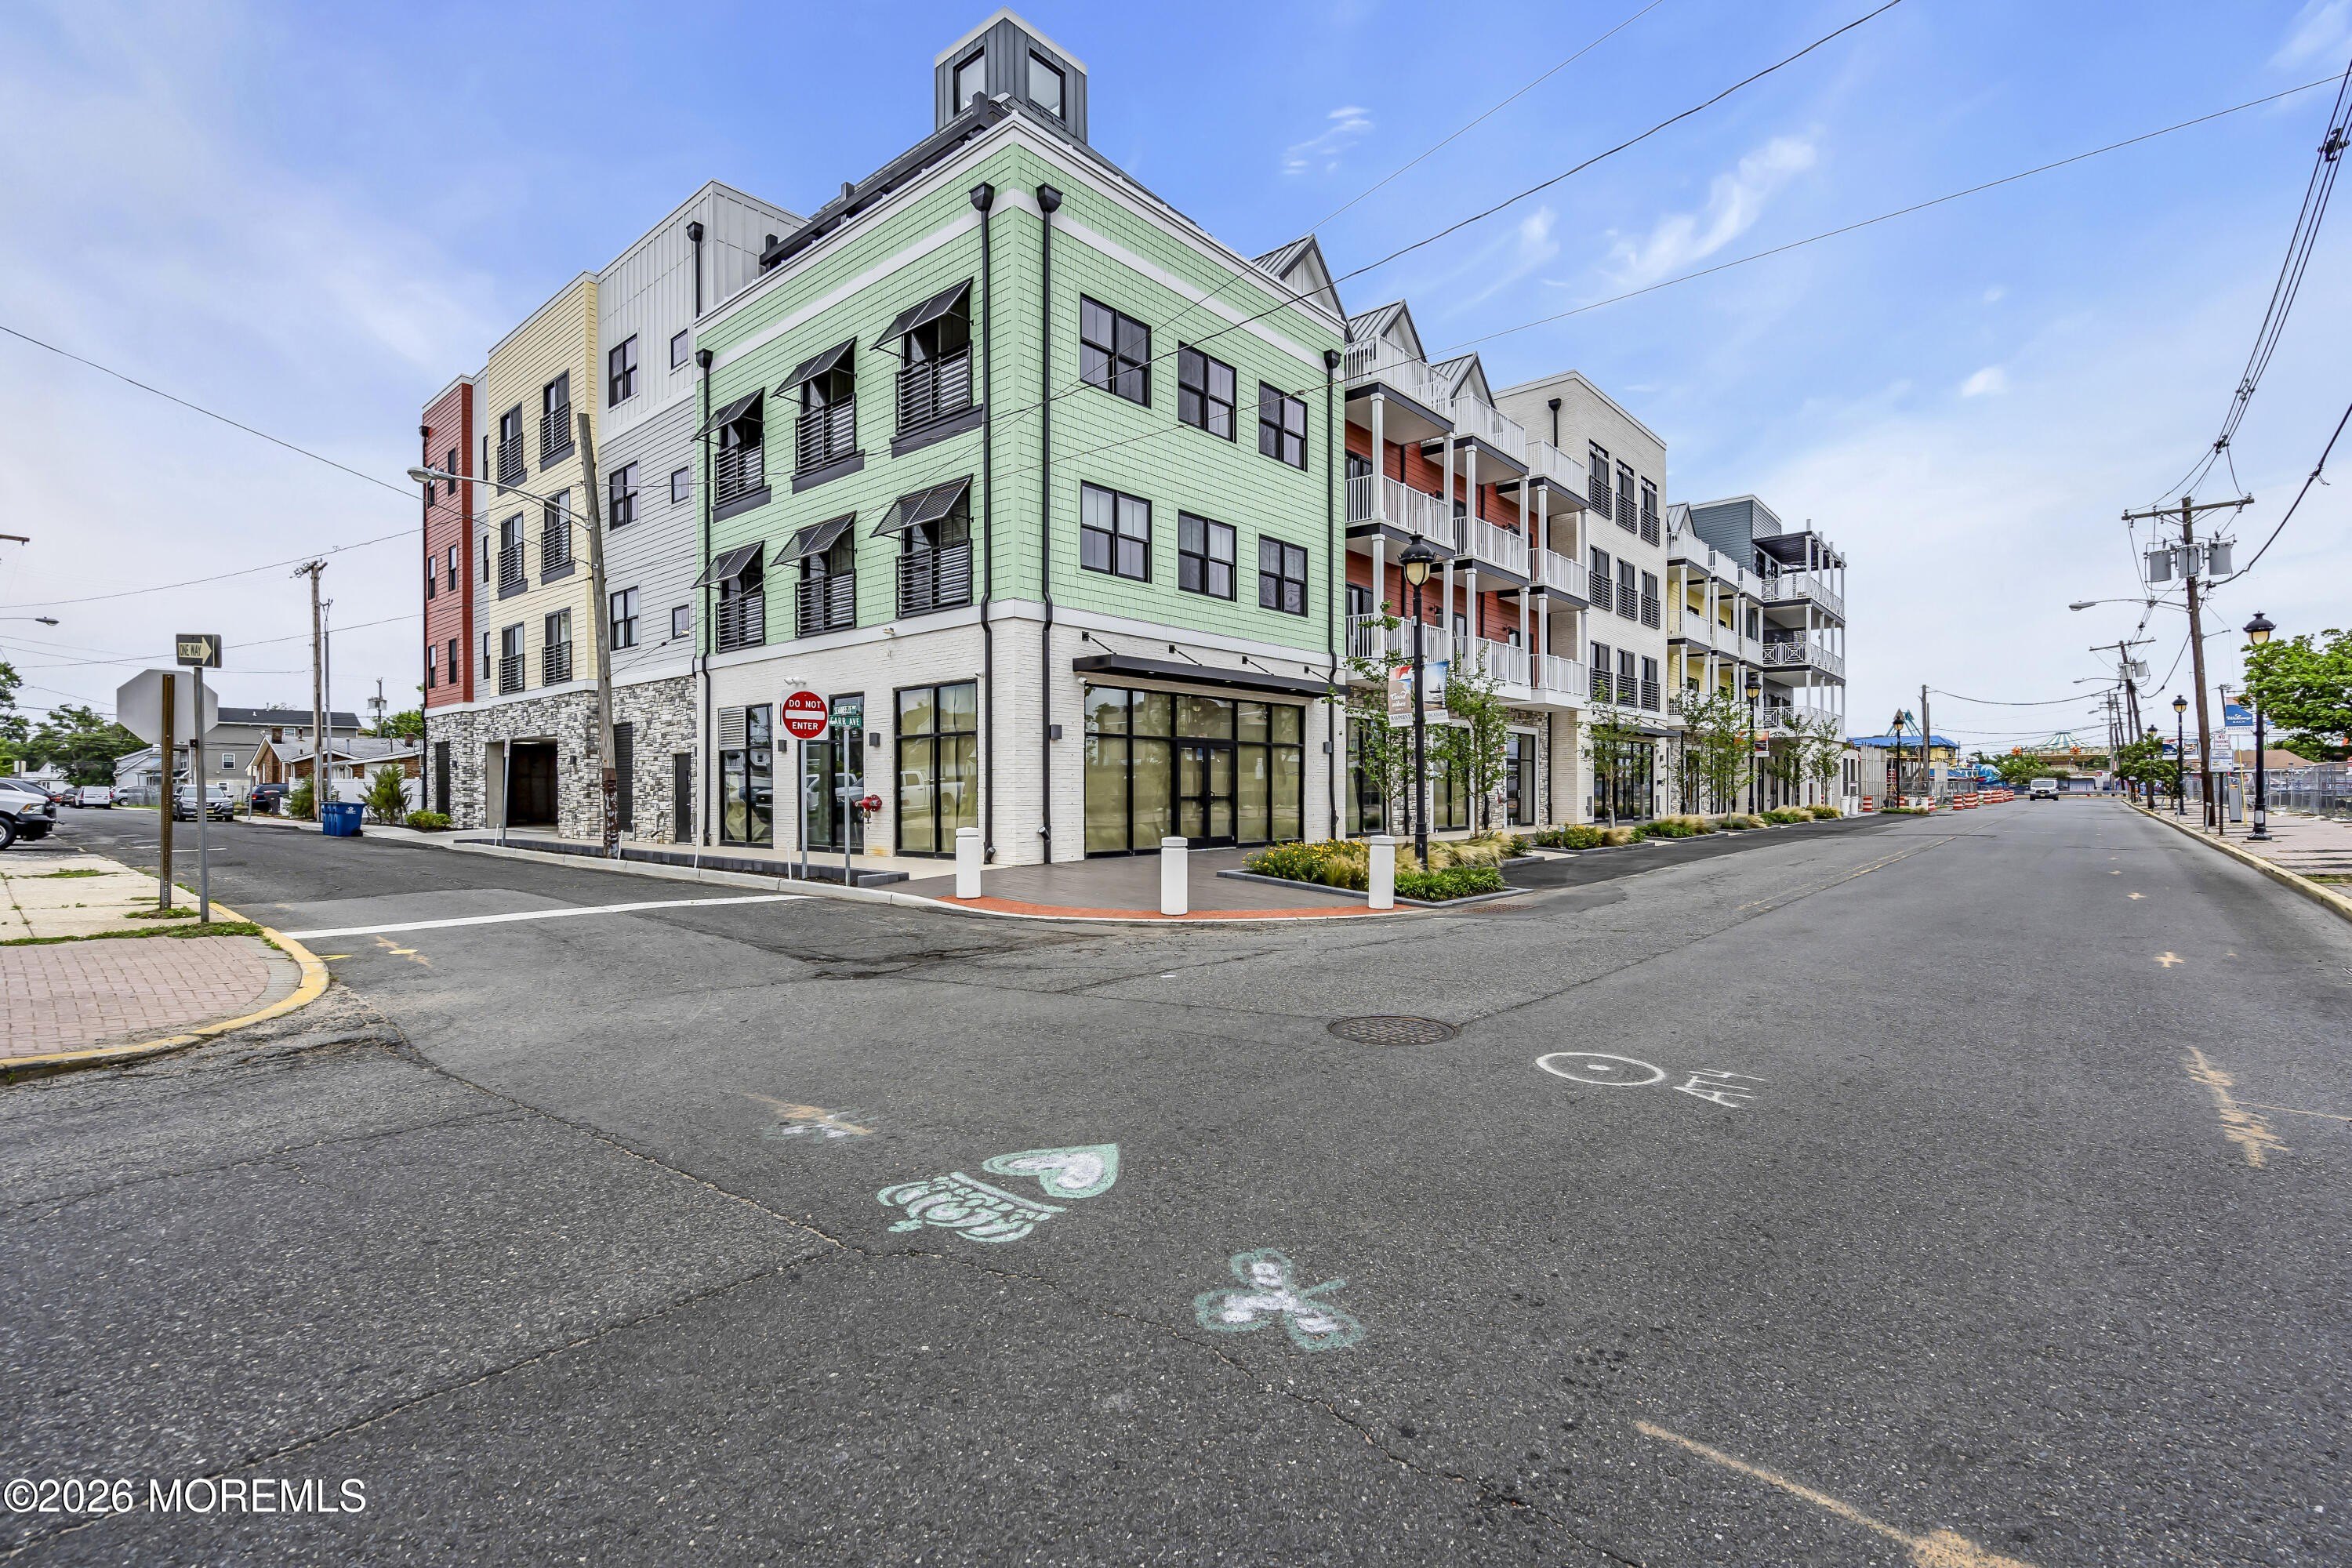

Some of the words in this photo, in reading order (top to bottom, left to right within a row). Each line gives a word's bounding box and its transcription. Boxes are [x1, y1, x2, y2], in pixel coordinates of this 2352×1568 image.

[180, 644, 189, 656] ONE
[191, 644, 201, 656] WAY
[1390, 691, 1407, 700] Good
[789, 699, 800, 708] DO
[805, 700, 822, 709] NOT
[792, 721, 818, 730] ENTER
[829, 717, 847, 725] CARR
[849, 717, 860, 726] AVE
